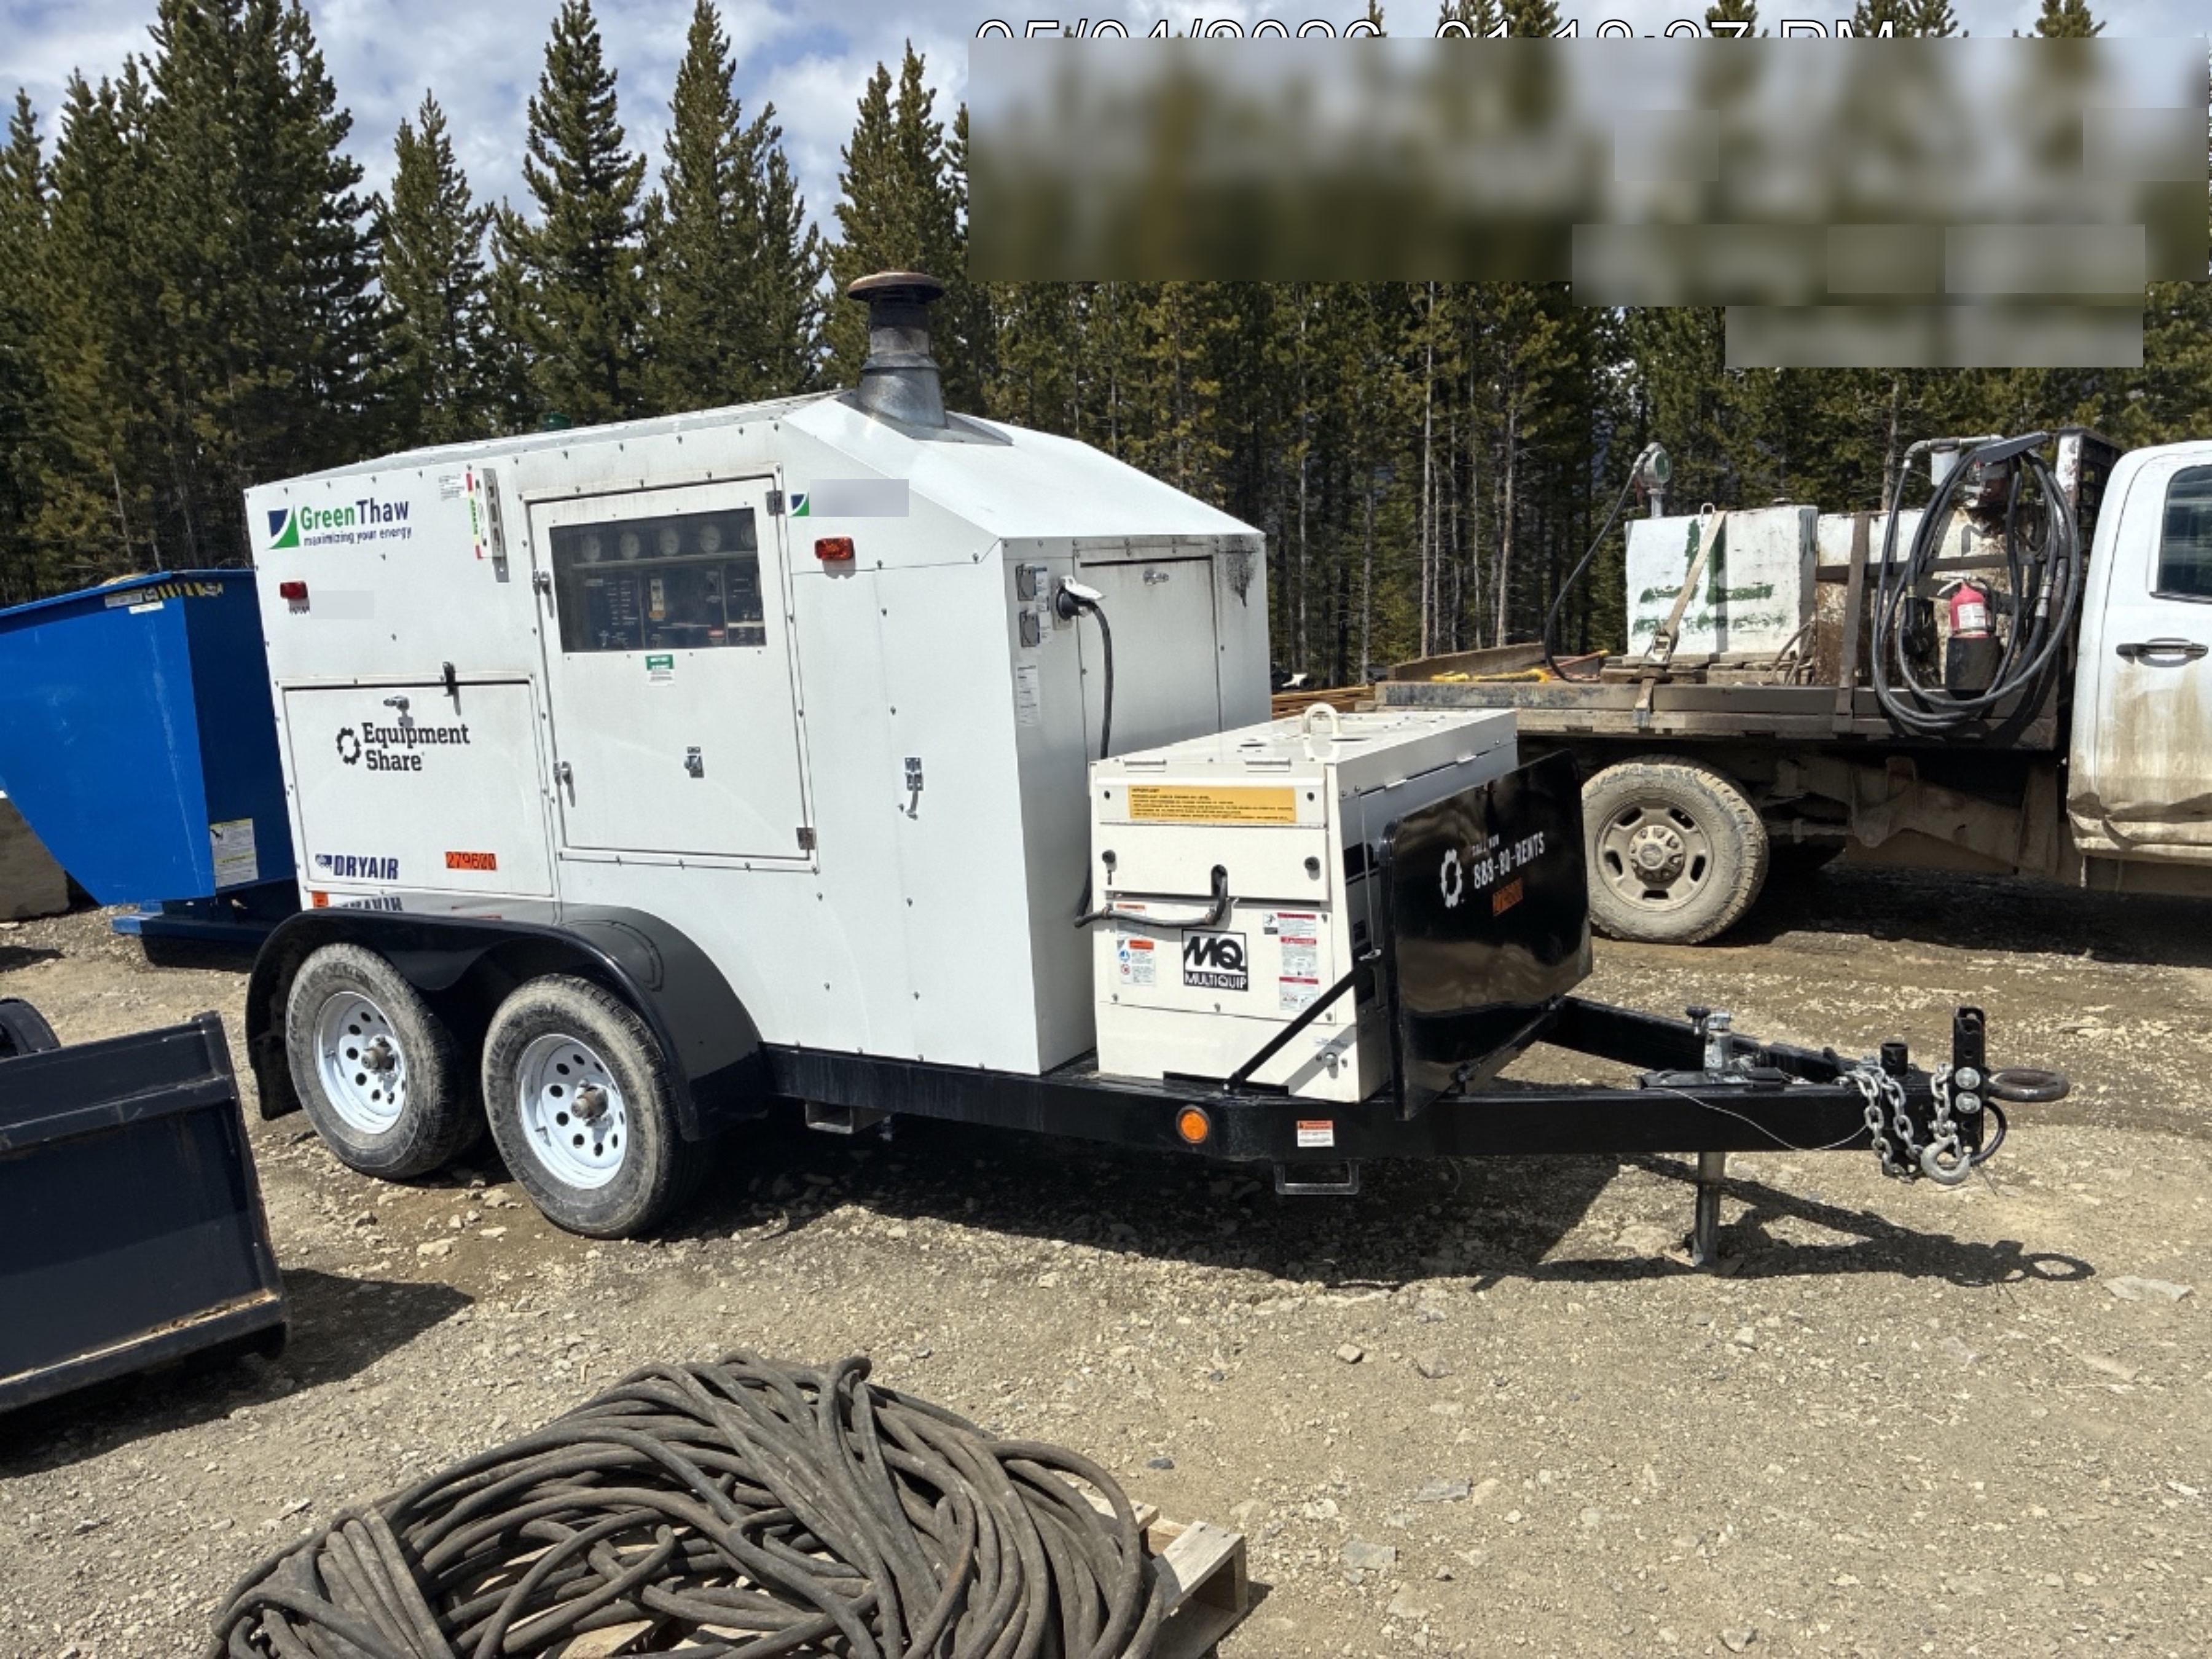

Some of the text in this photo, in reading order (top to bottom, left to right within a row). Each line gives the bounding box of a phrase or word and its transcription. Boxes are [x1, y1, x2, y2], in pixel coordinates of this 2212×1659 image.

[304, 526, 412, 546] maximizing your energy
[361, 722, 471, 748] Equipment
[366, 749, 423, 771] Share
[333, 855, 399, 880] DRYAIR
[1183, 935, 1247, 971] MQ
[1185, 972, 1247, 989] MULTIQUIP
